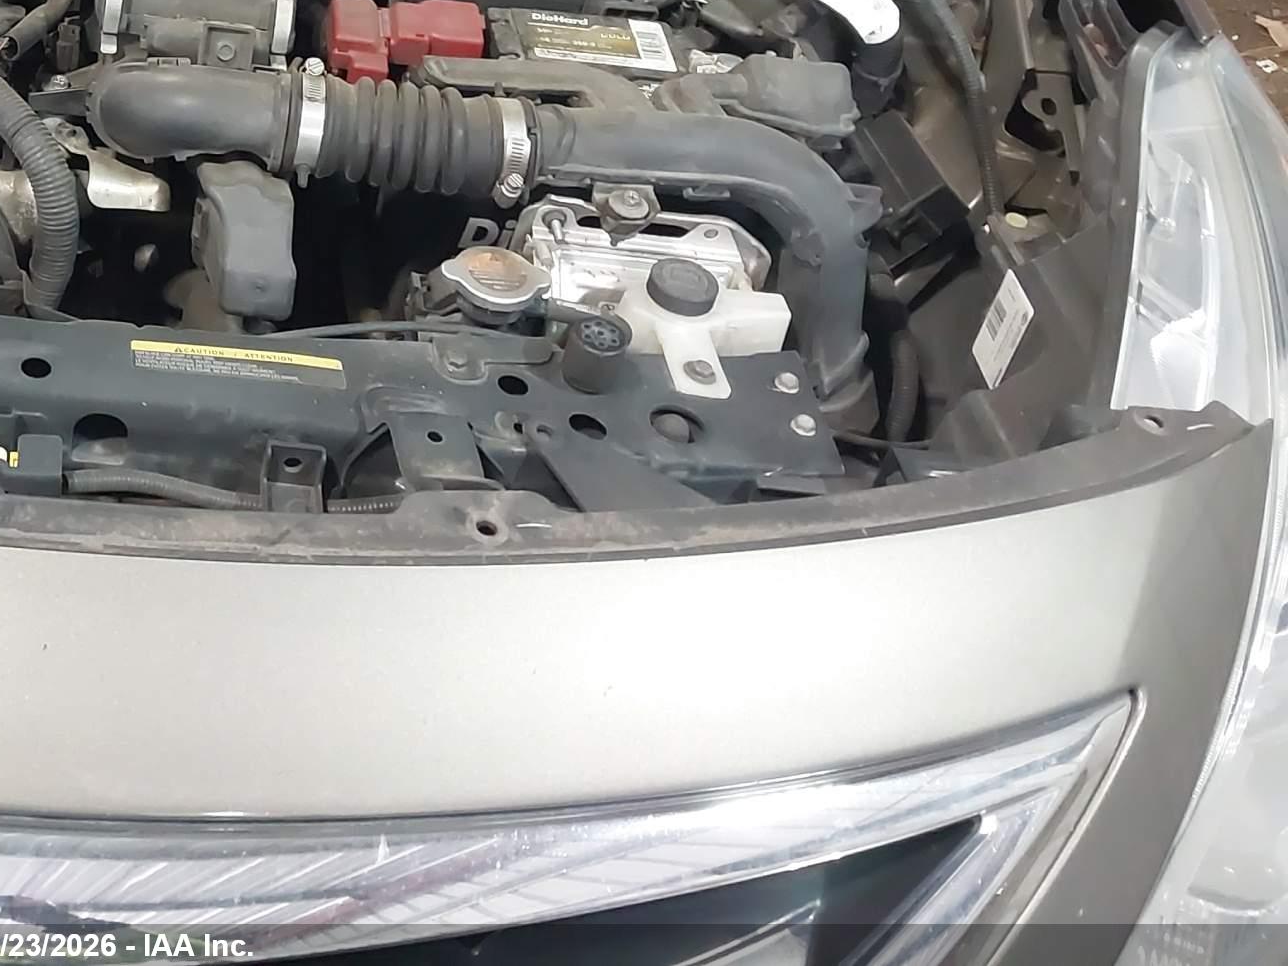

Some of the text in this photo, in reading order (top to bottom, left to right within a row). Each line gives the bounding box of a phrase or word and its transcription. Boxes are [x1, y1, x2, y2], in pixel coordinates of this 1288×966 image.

[532, 13, 589, 26] DieHard
[183, 348, 225, 356] CAUTION
[244, 353, 294, 362] ATTENTION
